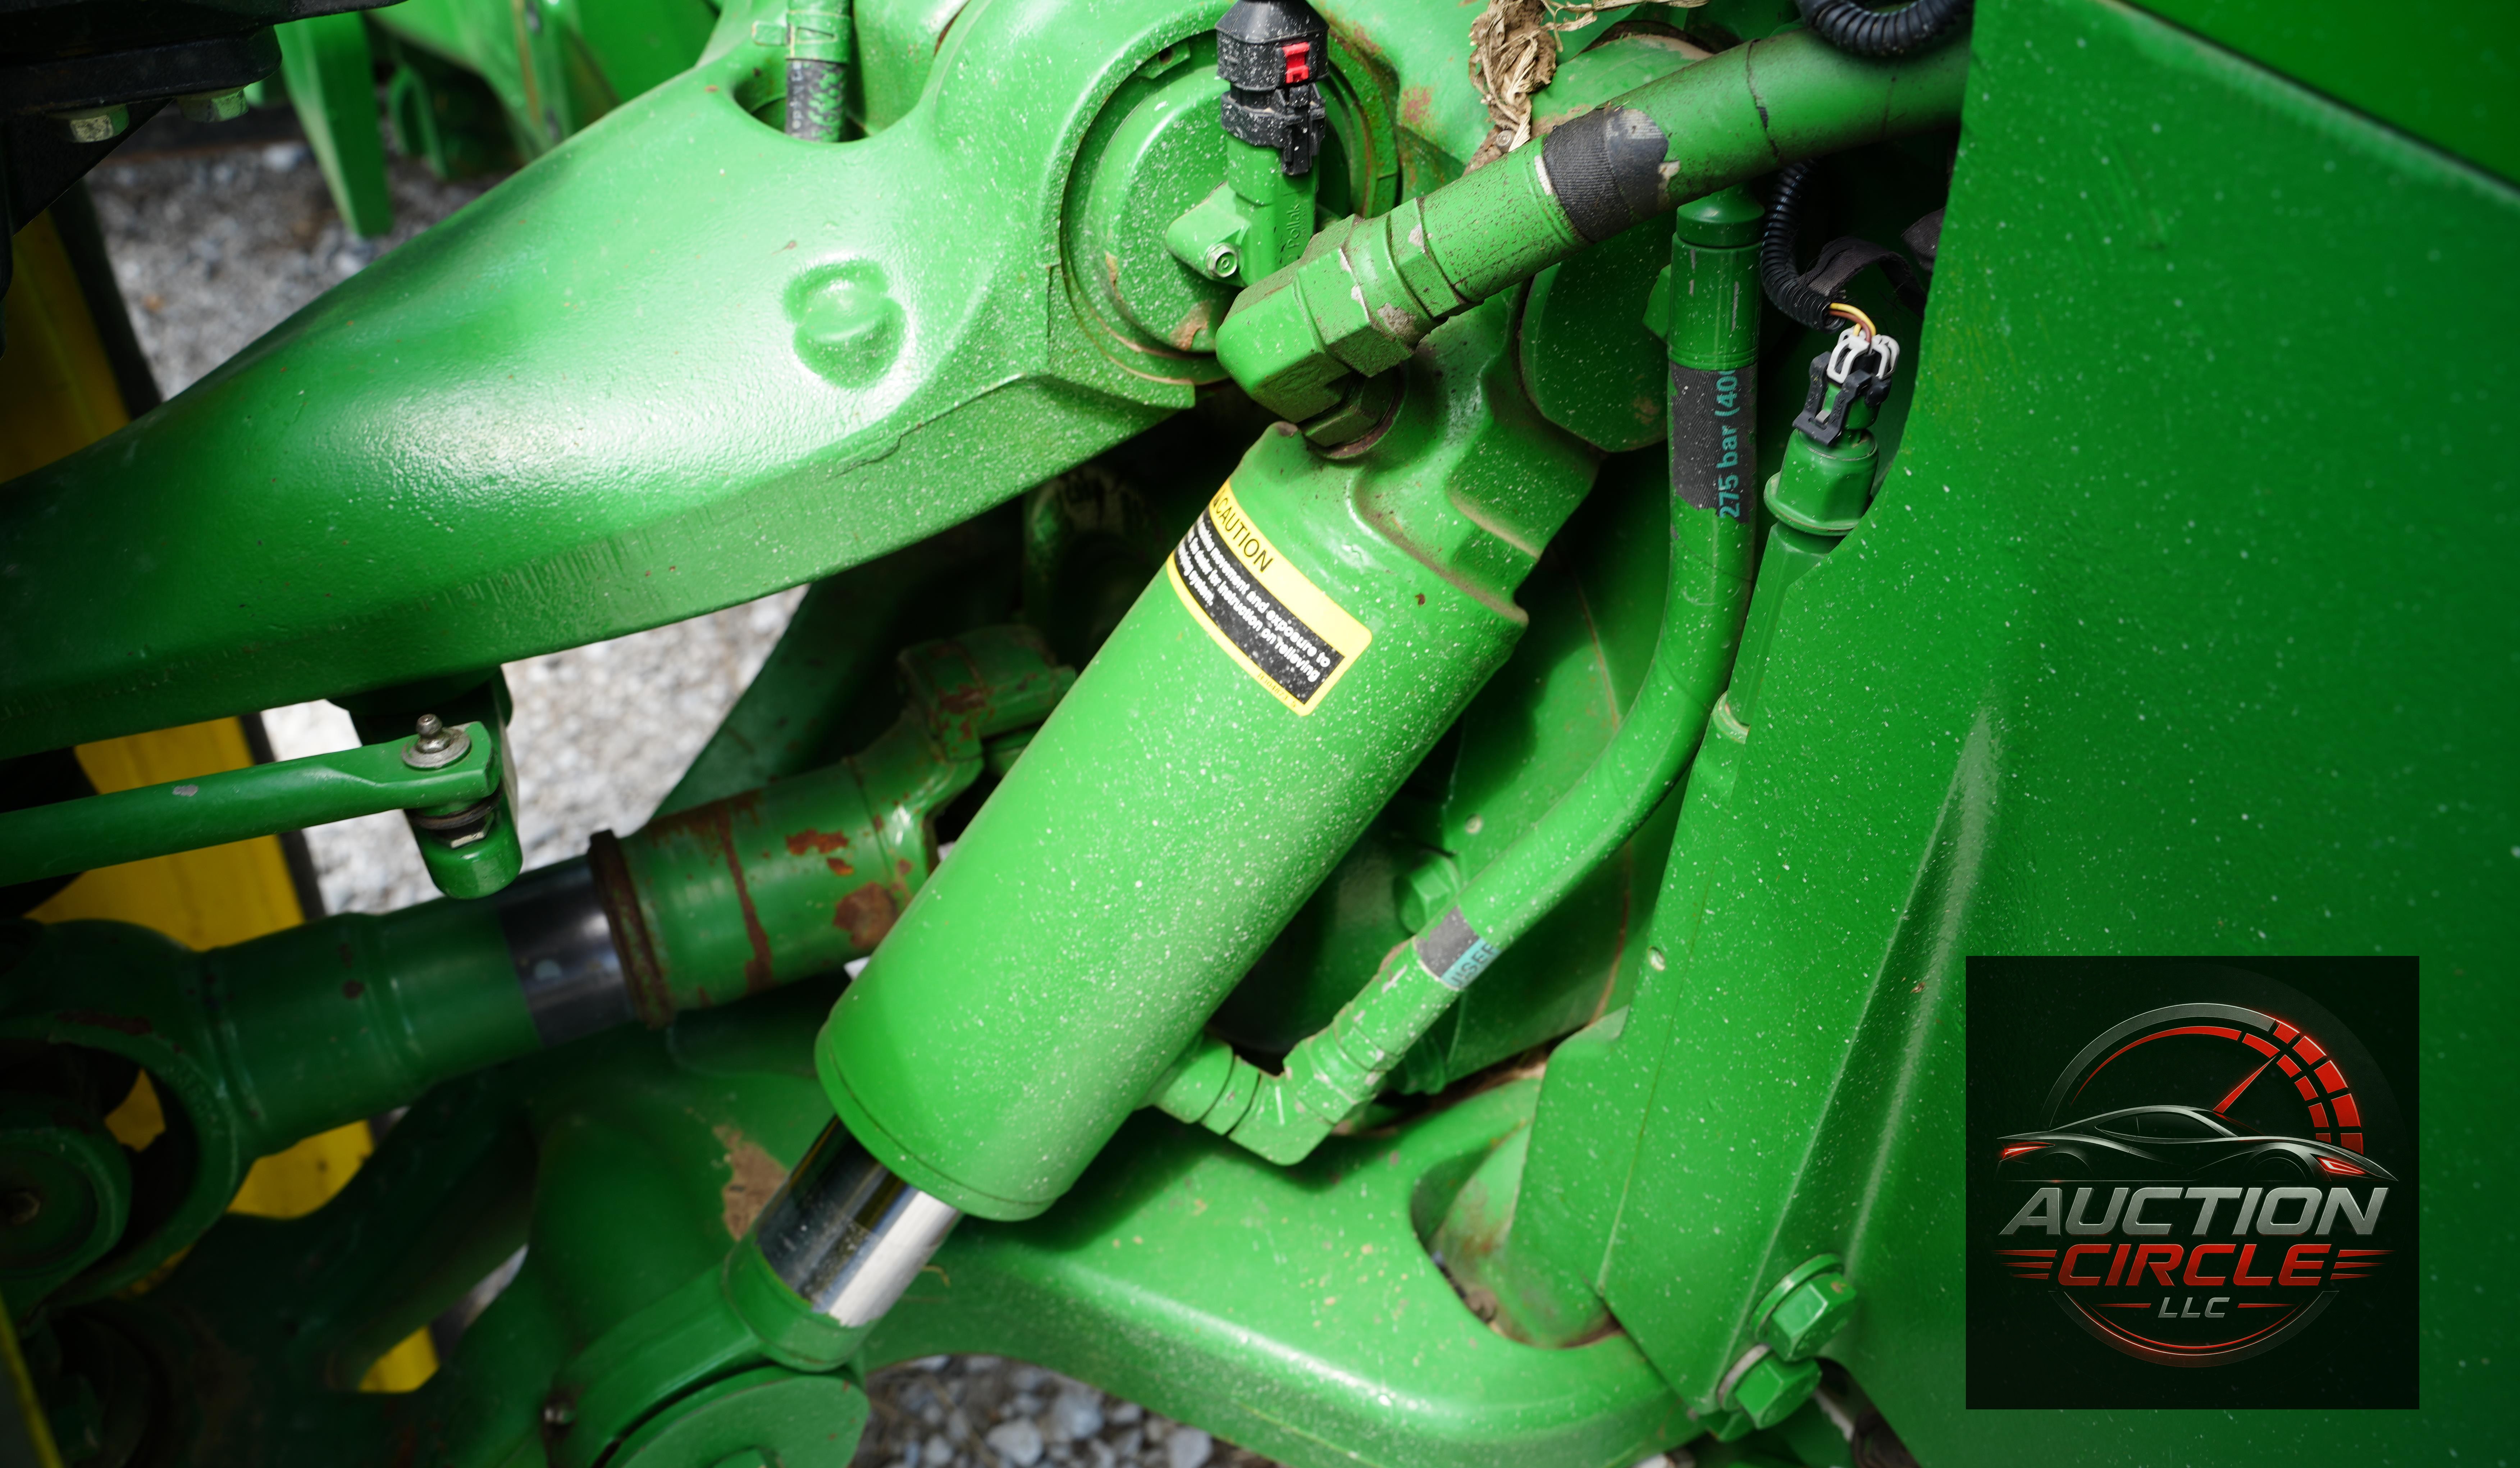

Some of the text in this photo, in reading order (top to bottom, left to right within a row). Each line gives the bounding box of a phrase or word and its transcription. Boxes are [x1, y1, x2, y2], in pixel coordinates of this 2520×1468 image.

[1286, 202, 1300, 249] Pollak
[1715, 370, 1740, 518] 275 bar (40
[1216, 497, 1273, 573] CAUTION
[1208, 569, 1222, 587] for
[1217, 580, 1263, 632] instruction
[1261, 628, 1277, 645] on
[1274, 642, 1321, 682] relieving
[1210, 547, 1250, 595] movement
[1246, 591, 1270, 614] and
[1266, 610, 1317, 657] exposure
[1316, 651, 1330, 667] to
